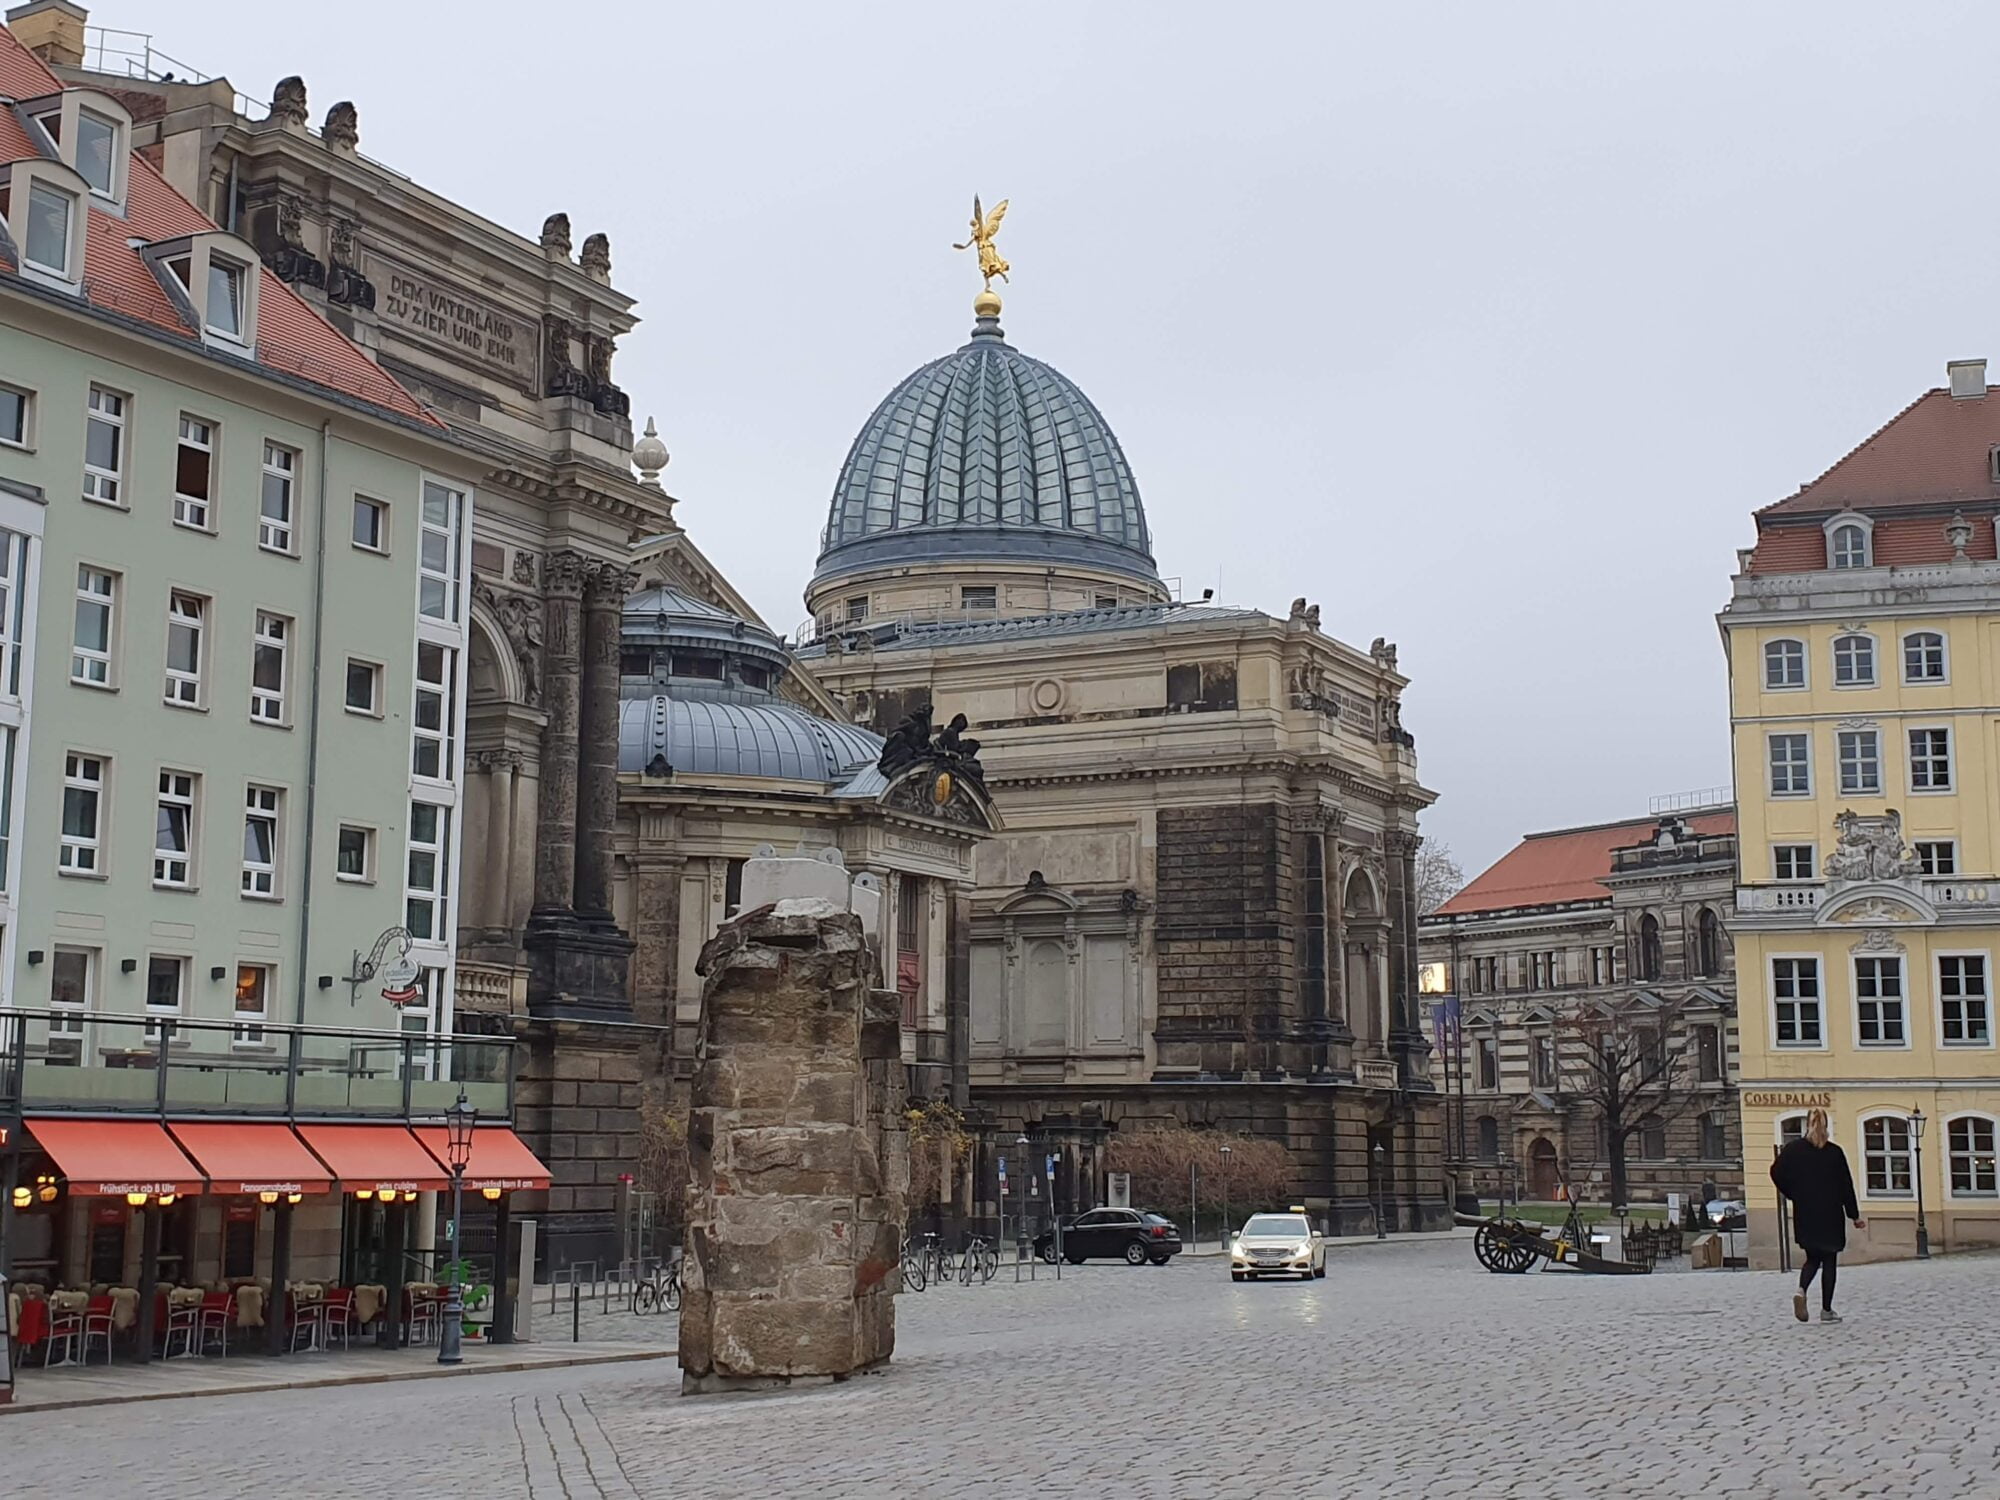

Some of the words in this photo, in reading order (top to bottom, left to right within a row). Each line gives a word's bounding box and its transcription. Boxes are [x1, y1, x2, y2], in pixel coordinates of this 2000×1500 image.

[387, 295, 408, 319] ZU
[412, 306, 448, 337] ZIER
[452, 323, 482, 350] UND
[487, 338, 516, 365] EHR
[391, 275, 423, 304] DEM
[429, 291, 513, 342] VATERLAND
[100, 1183, 139, 1193] Frühstück
[140, 1183, 153, 1193] ab
[161, 1183, 177, 1193] Uhr
